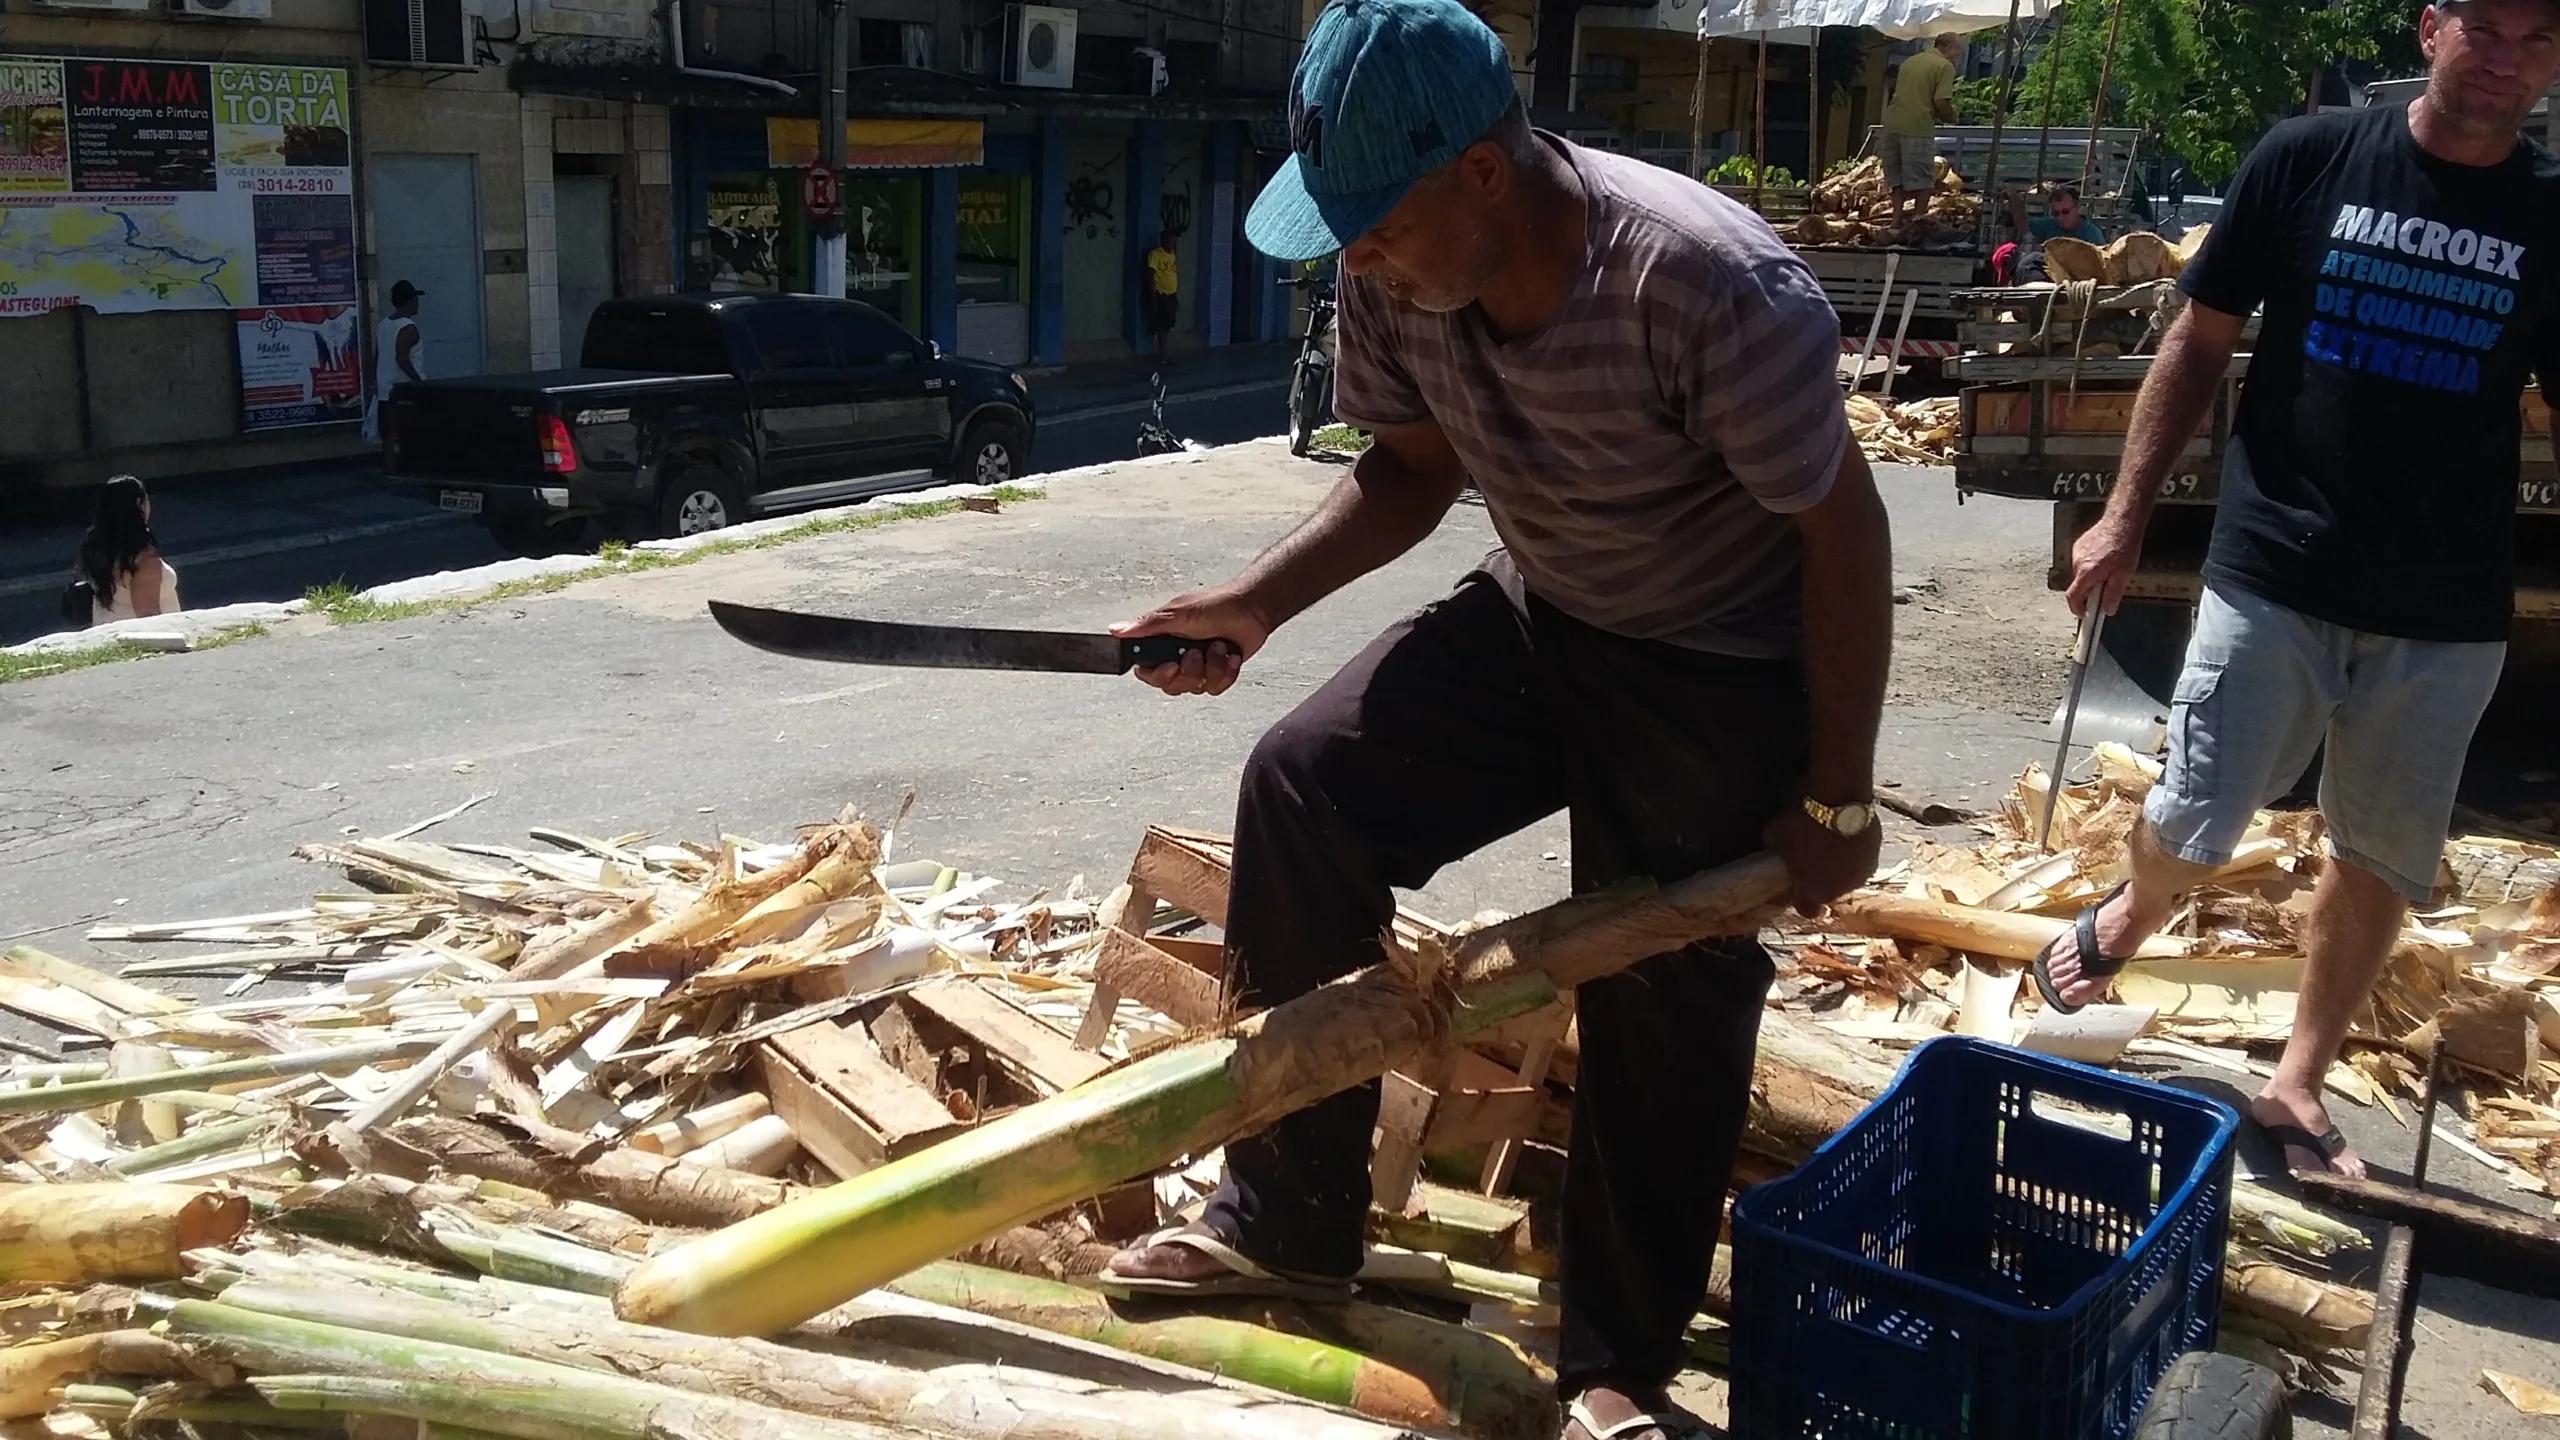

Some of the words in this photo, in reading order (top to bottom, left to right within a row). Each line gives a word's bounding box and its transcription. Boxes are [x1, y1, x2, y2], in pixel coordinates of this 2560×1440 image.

[220, 68, 292, 93] CASA
[302, 72, 335, 95] DA
[74, 104, 153, 120] Lanternagem
[156, 109, 164, 118] e
[166, 106, 209, 119] Pintura
[222, 94, 342, 126] TORTA
[257, 178, 334, 192] 3014-2810
[2330, 203, 2527, 281] MACROEX
[2319, 249, 2515, 315] ATENDIMENTO
[2315, 282, 2354, 318] DE
[2356, 292, 2504, 351] QUALIDADE
[2304, 320, 2480, 396] EXTREMA
